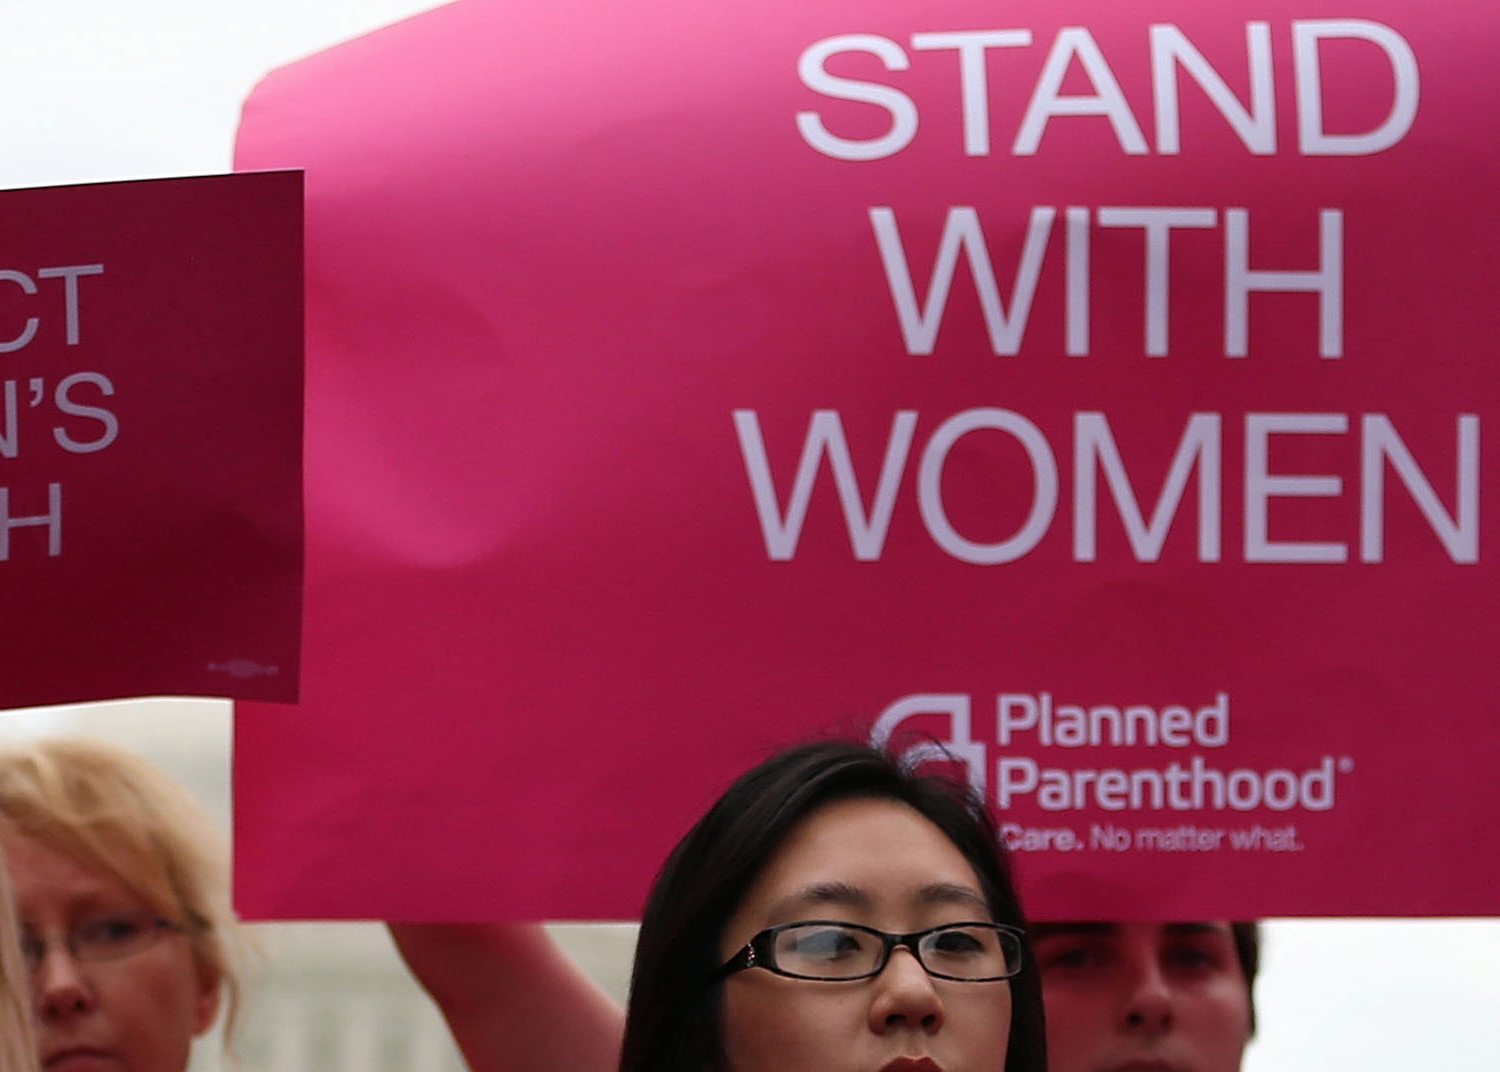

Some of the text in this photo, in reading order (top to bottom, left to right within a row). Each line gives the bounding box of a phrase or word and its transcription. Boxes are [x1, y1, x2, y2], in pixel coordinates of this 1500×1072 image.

[795, 18, 1421, 161] STAND
[868, 205, 1345, 359] WITH
[732, 407, 1481, 565] WOMEN
[997, 691, 1230, 748] Planned
[1001, 823, 1304, 851] Care. No matter what.
